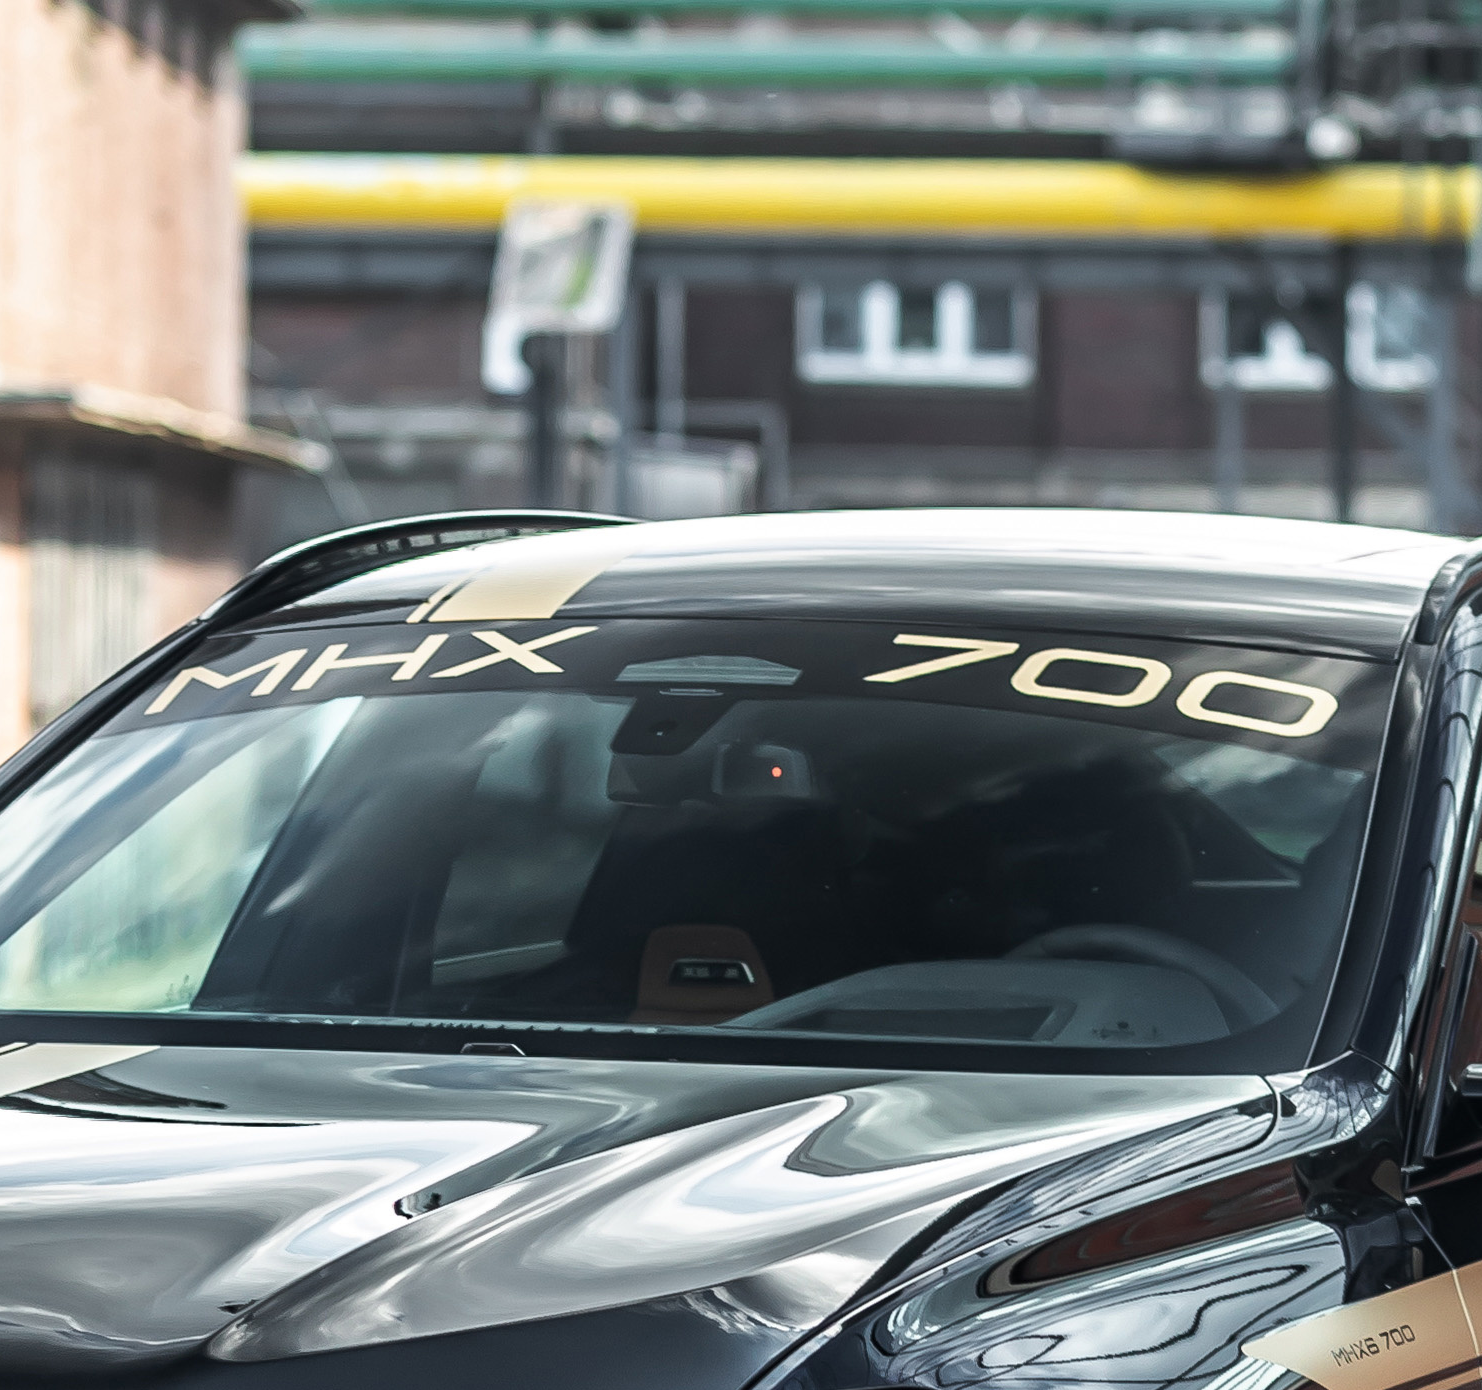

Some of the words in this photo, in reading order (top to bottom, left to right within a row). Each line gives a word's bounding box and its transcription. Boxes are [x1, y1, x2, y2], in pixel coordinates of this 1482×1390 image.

[144, 626, 600, 715] MHX
[863, 633, 1339, 738] 700
[1330, 1338, 1380, 1367] MHX6
[1379, 1324, 1416, 1350] 700
